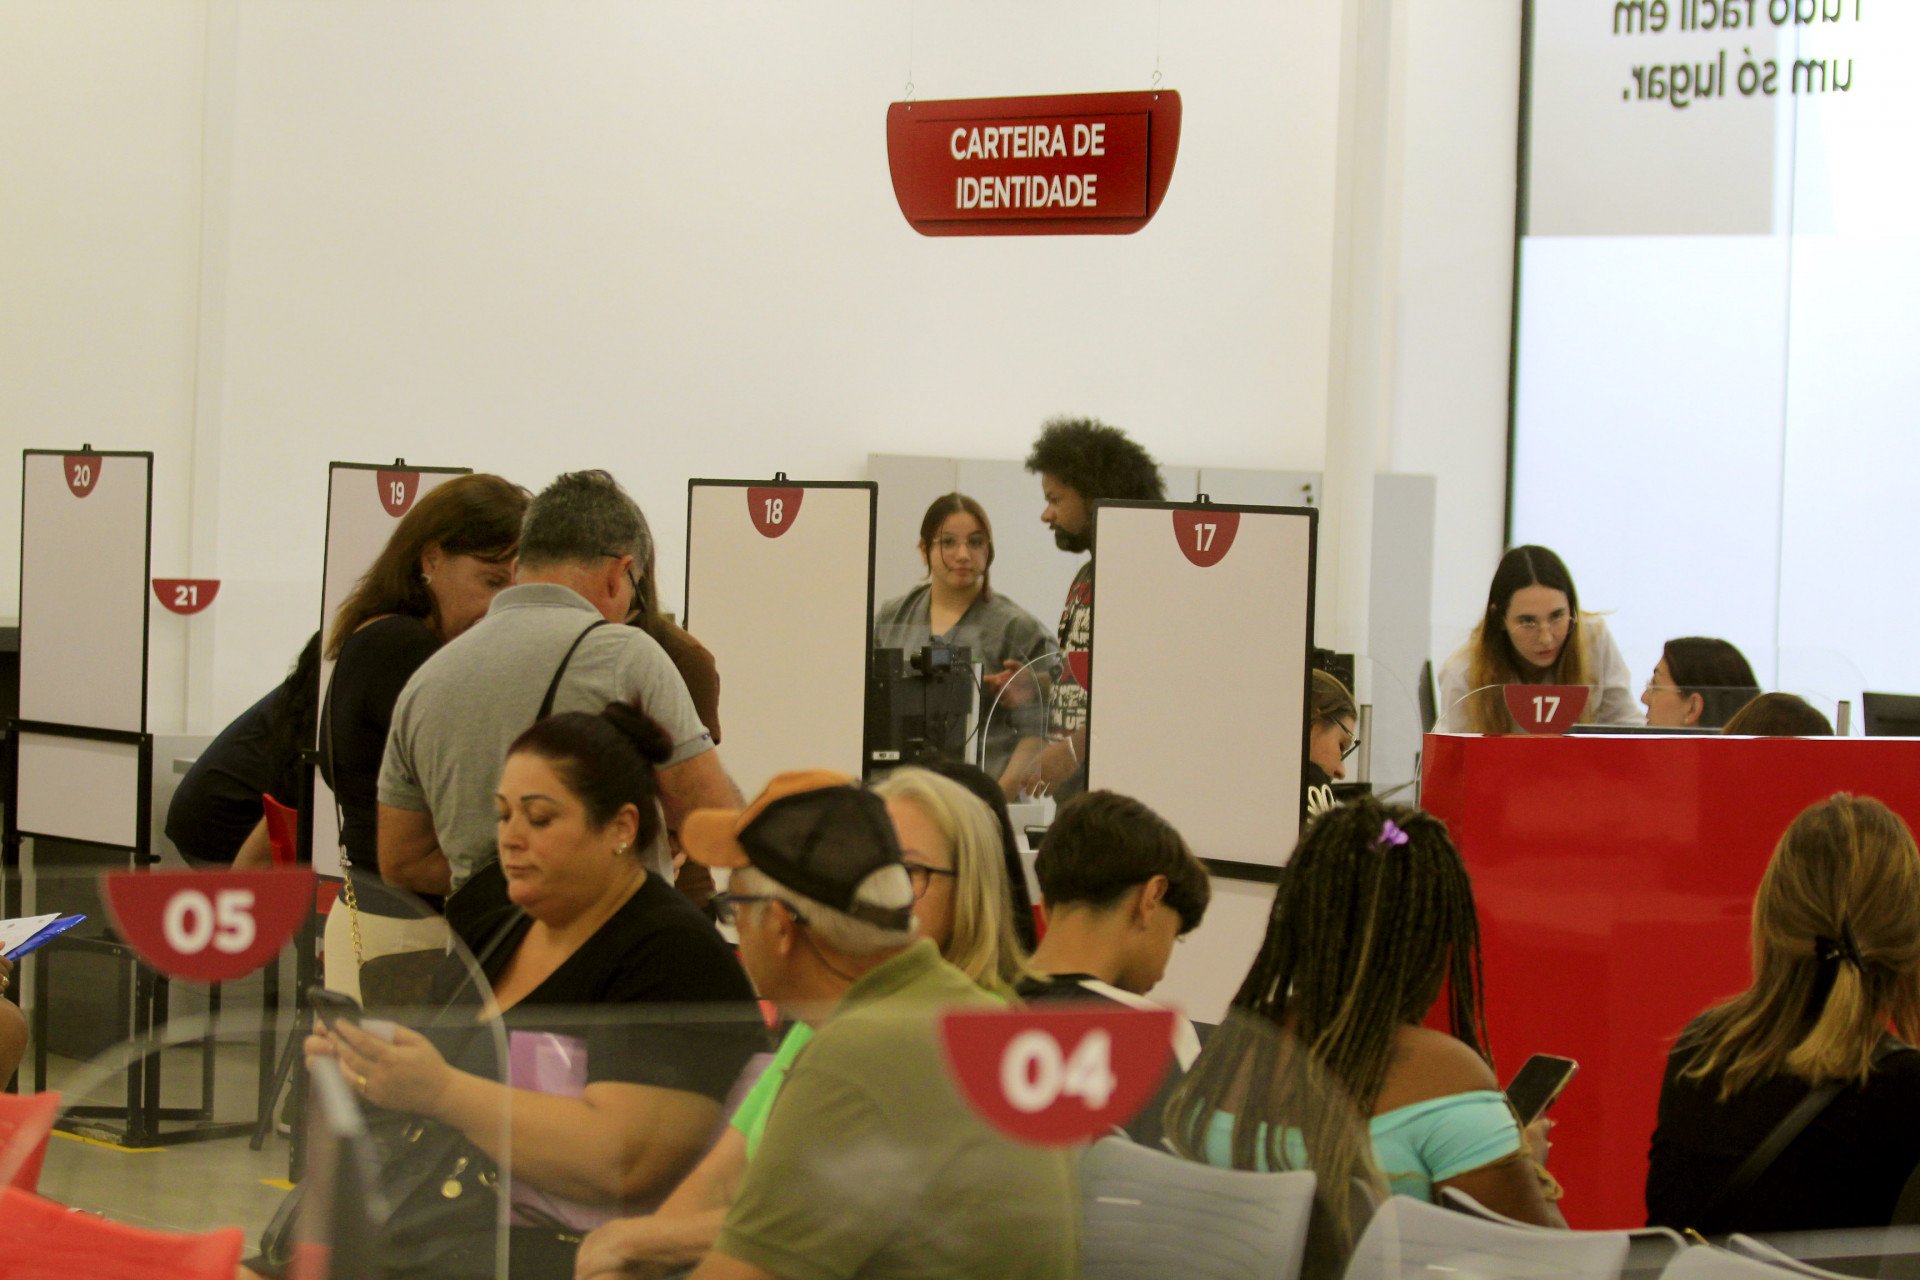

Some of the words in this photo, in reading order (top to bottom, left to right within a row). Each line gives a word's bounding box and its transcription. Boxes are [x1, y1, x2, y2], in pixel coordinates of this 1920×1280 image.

[950, 124, 1068, 161] CARTEIRA
[1073, 123, 1106, 157] DE
[956, 174, 1098, 209] IDENTIDADE
[73, 464, 91, 487] 20
[390, 481, 405, 506] 19
[764, 498, 784, 525] 18
[1194, 523, 1217, 552] 17
[174, 585, 198, 606] 21
[1532, 695, 1561, 723] 17
[163, 889, 256, 954] 05
[1001, 1030, 1115, 1112] 04
